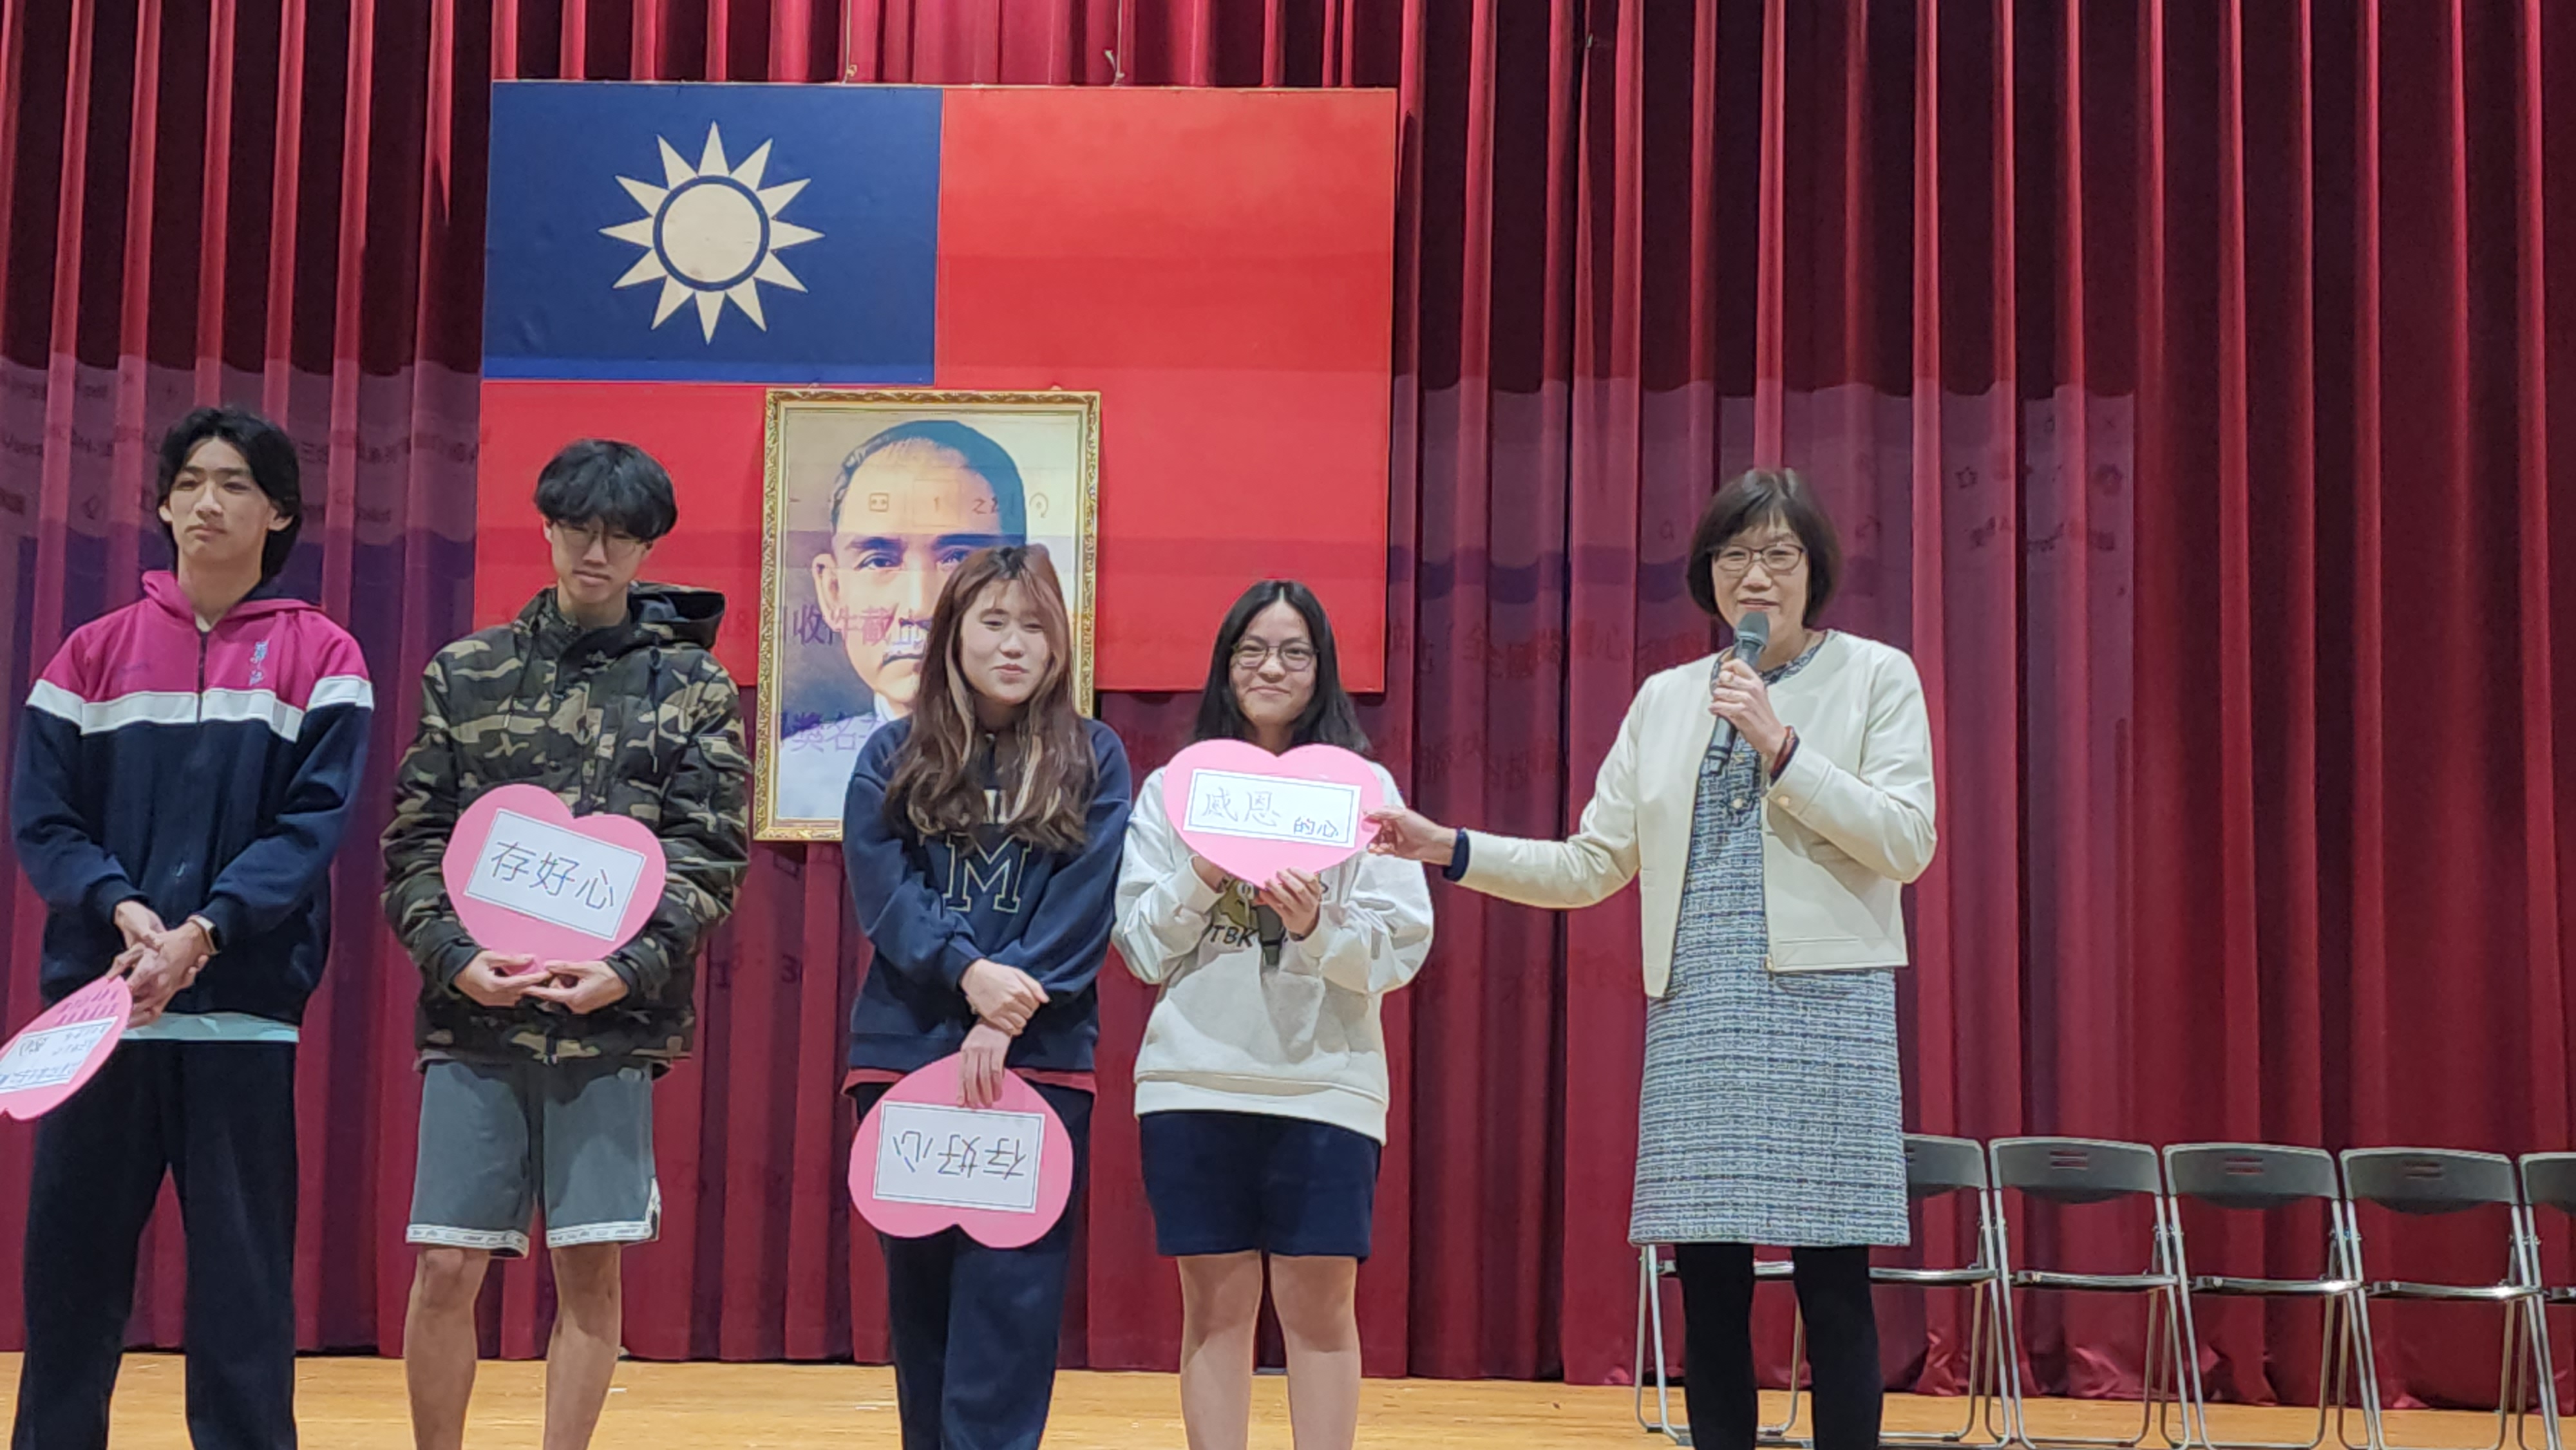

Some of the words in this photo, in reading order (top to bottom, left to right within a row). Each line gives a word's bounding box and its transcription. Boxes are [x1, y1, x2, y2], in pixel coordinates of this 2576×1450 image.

[1202, 787, 1282, 827] 感恩
[1293, 816, 1339, 838] 的心
[490, 841, 614, 910] 存好心
[942, 831, 1033, 913] M
[893, 1131, 1027, 1180] 存好心
